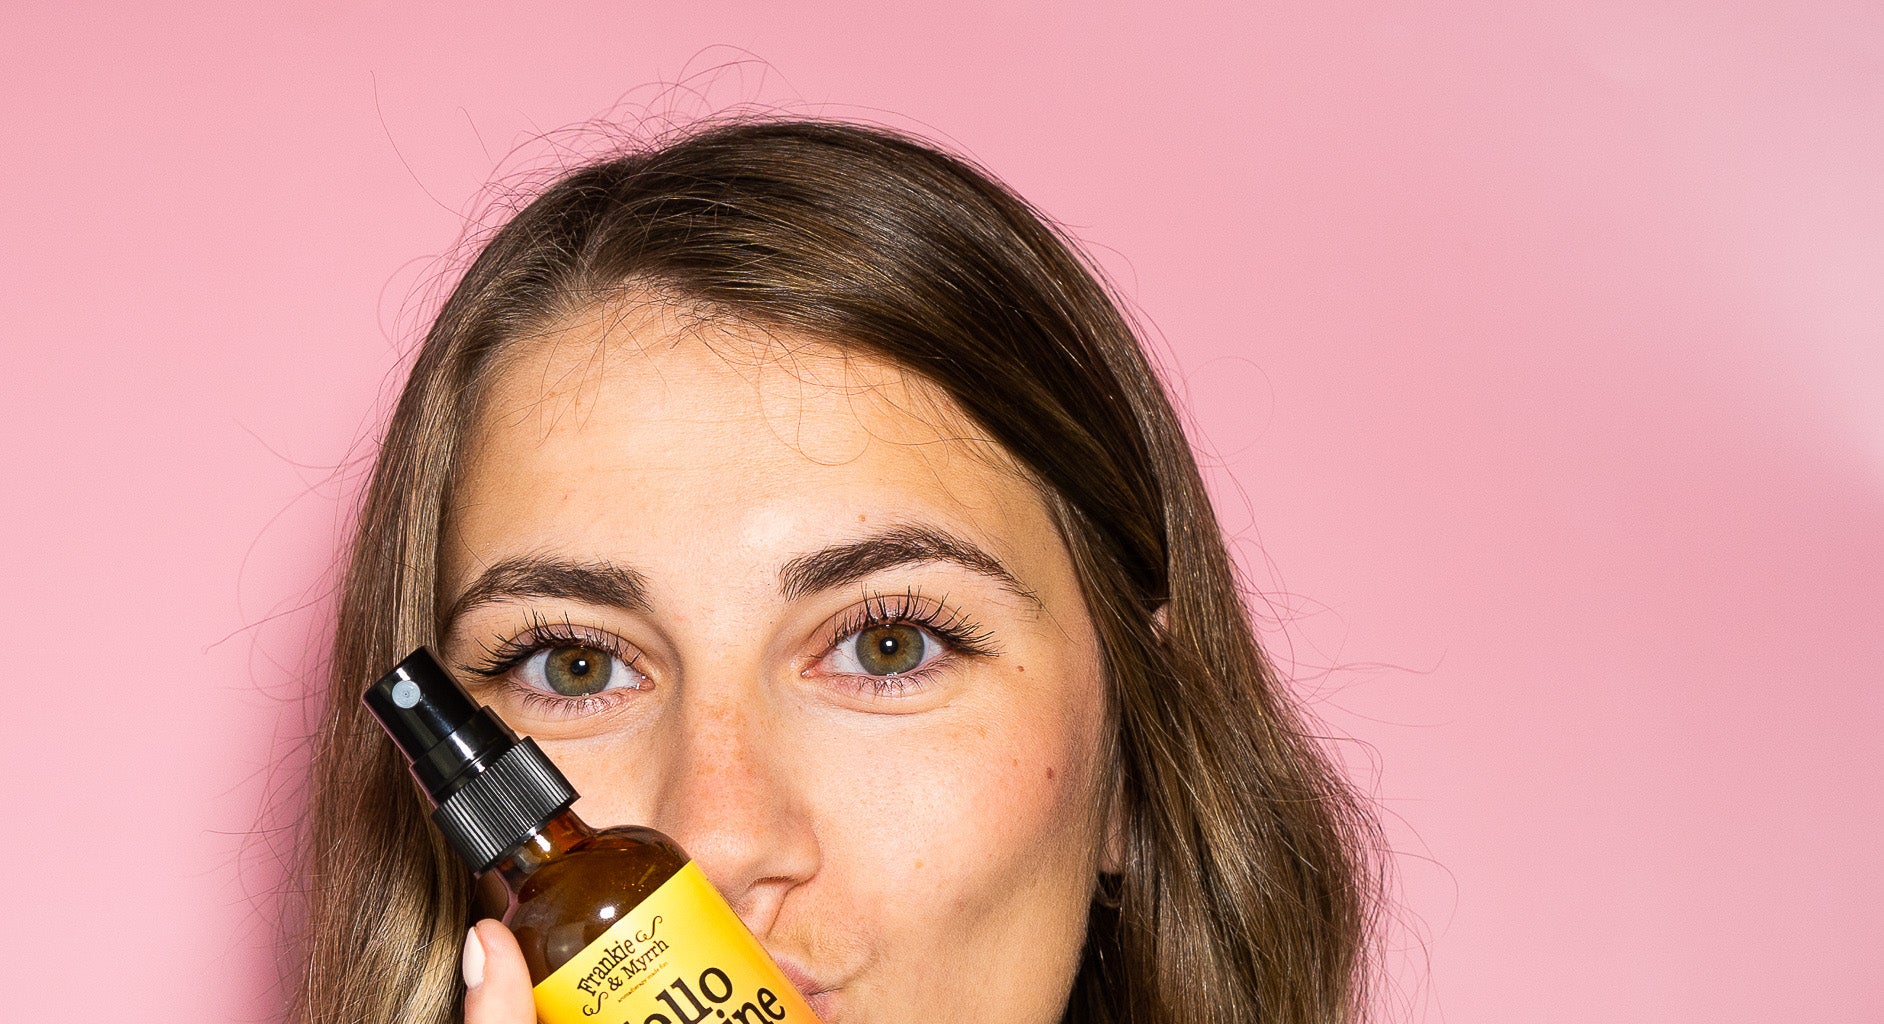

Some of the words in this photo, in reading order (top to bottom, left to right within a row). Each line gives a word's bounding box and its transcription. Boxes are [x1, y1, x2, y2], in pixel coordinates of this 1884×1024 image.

[577, 939, 636, 997] Frankie
[607, 976, 624, 991] &
[620, 940, 670, 980] Myrrh
